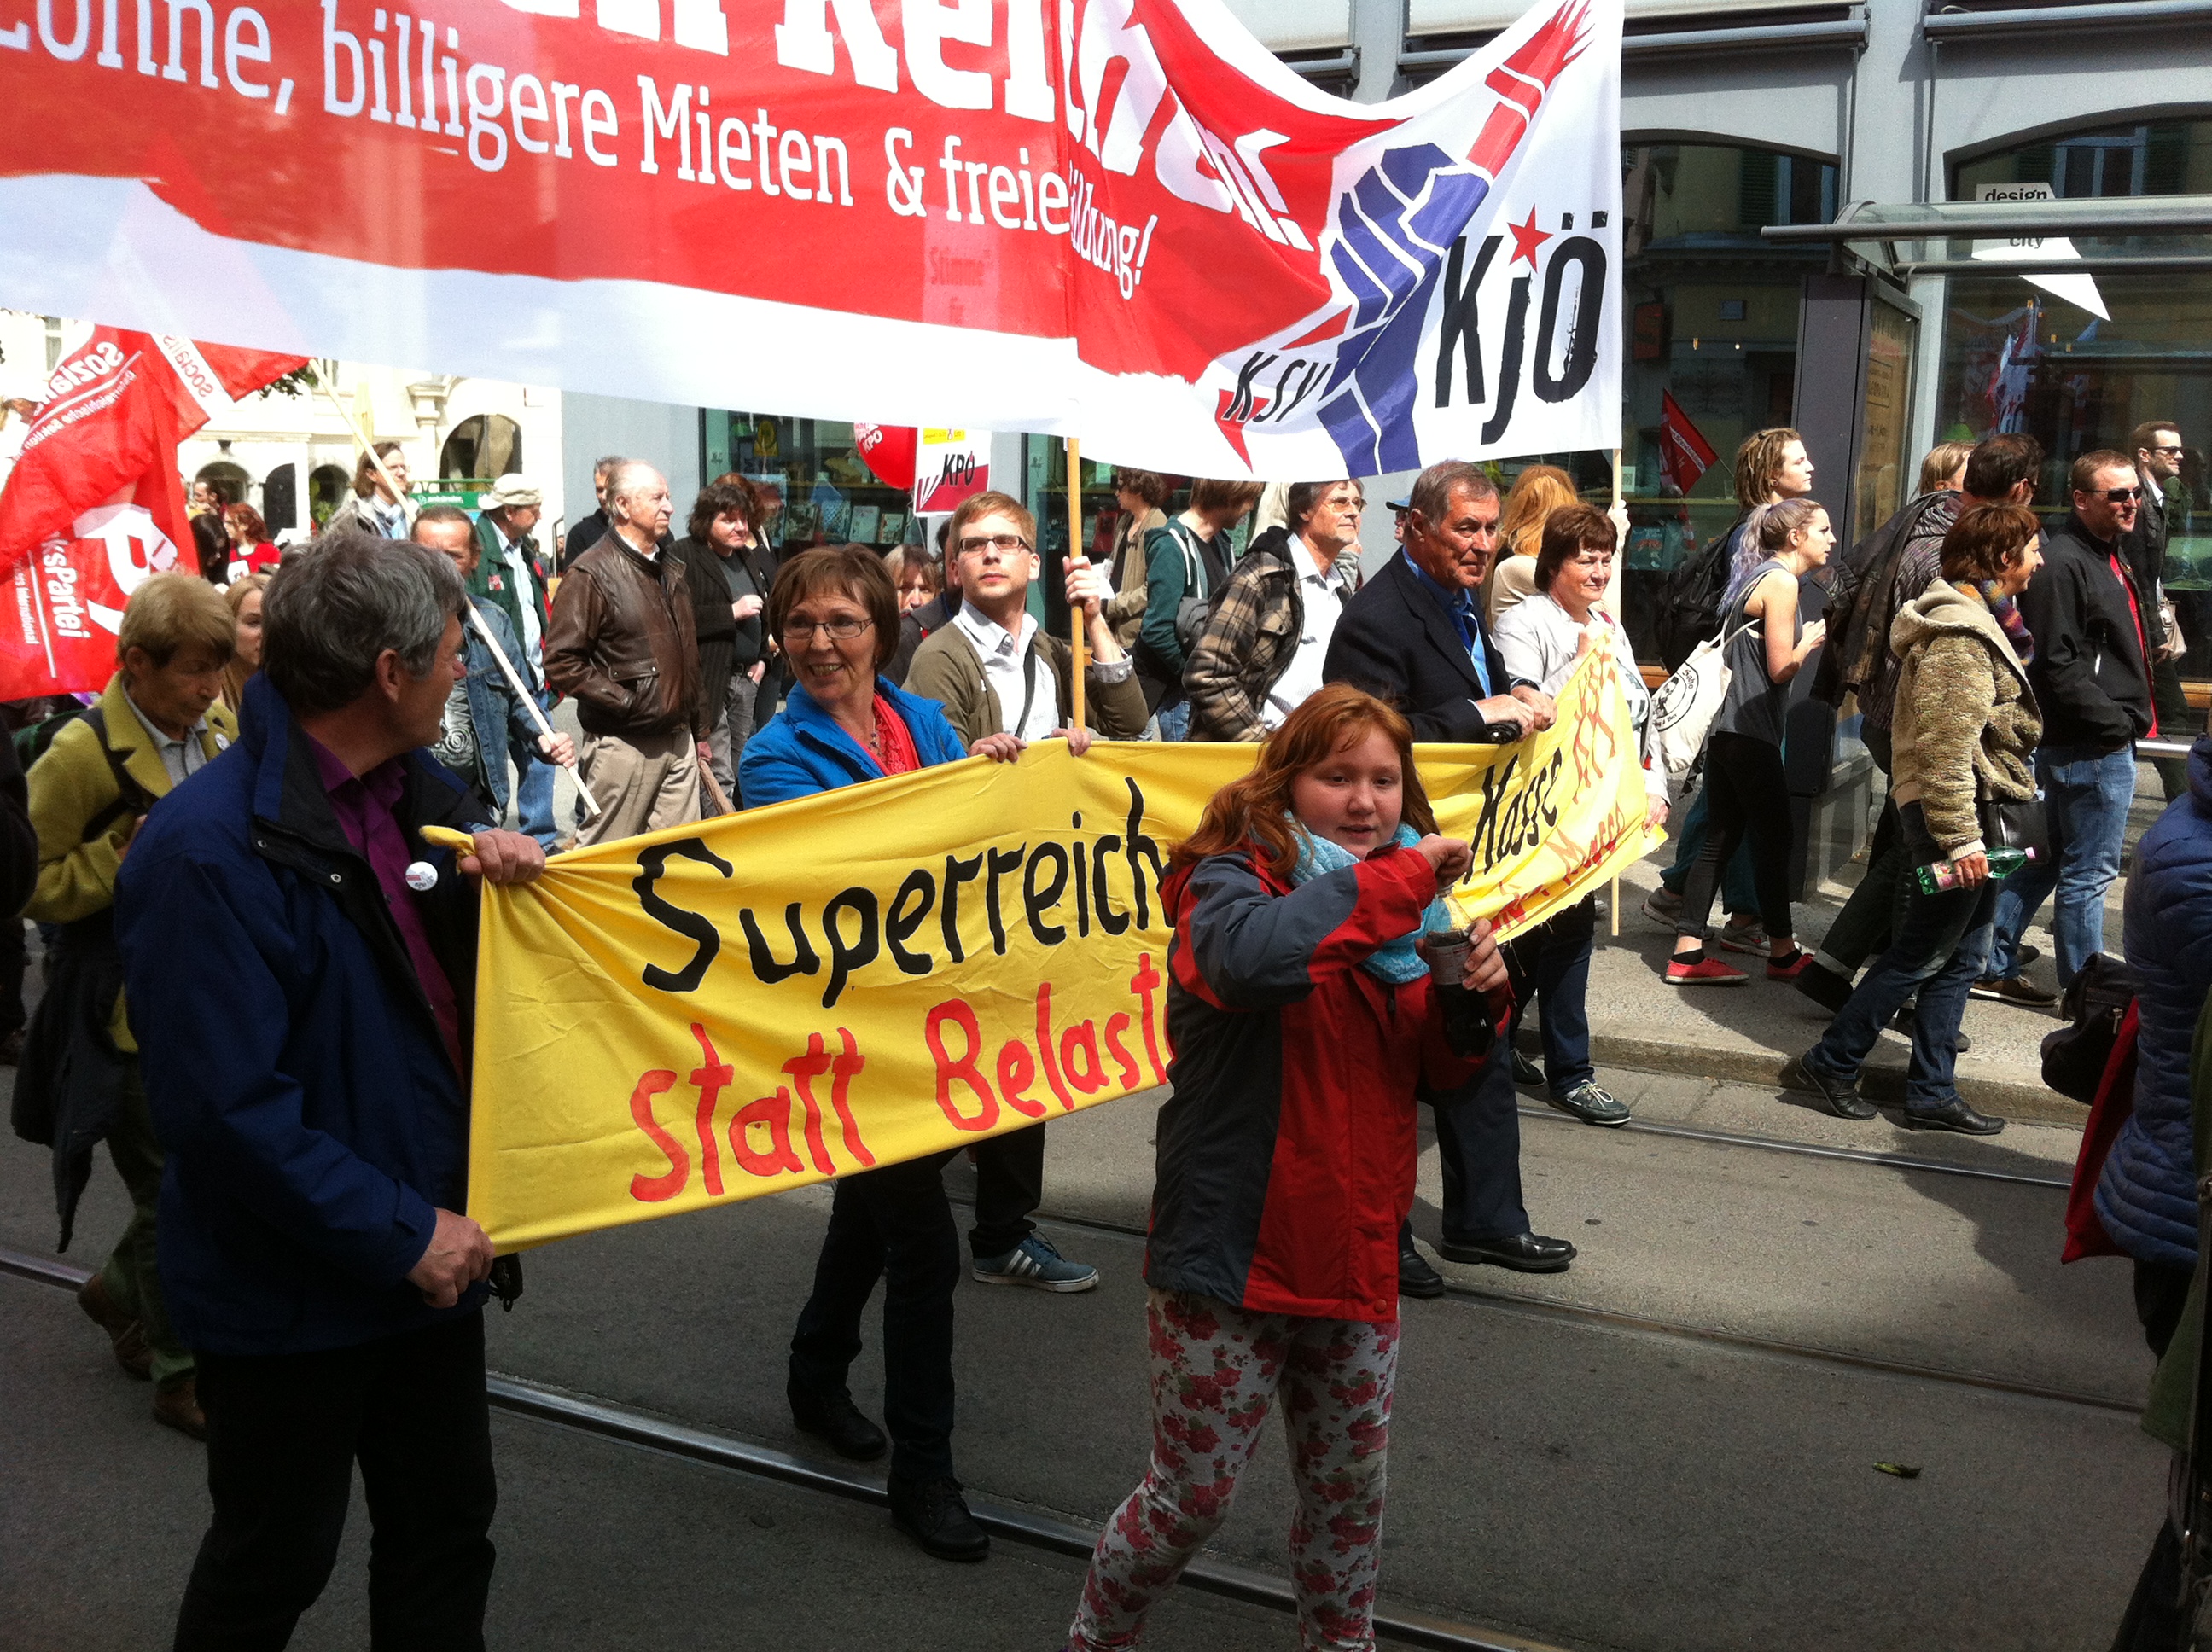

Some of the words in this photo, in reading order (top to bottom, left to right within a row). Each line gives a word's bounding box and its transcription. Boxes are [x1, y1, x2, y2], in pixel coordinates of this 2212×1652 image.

[322, 0, 619, 172] billigere
[637, 75, 853, 206] Mieten
[884, 127, 927, 218] &
[940, 135, 1071, 236] freie
[1068, 160, 1158, 300] ildung!
[632, 777, 1173, 1009] Superreich
[630, 1022, 876, 1202] statt
[925, 952, 1175, 1131] Belast
